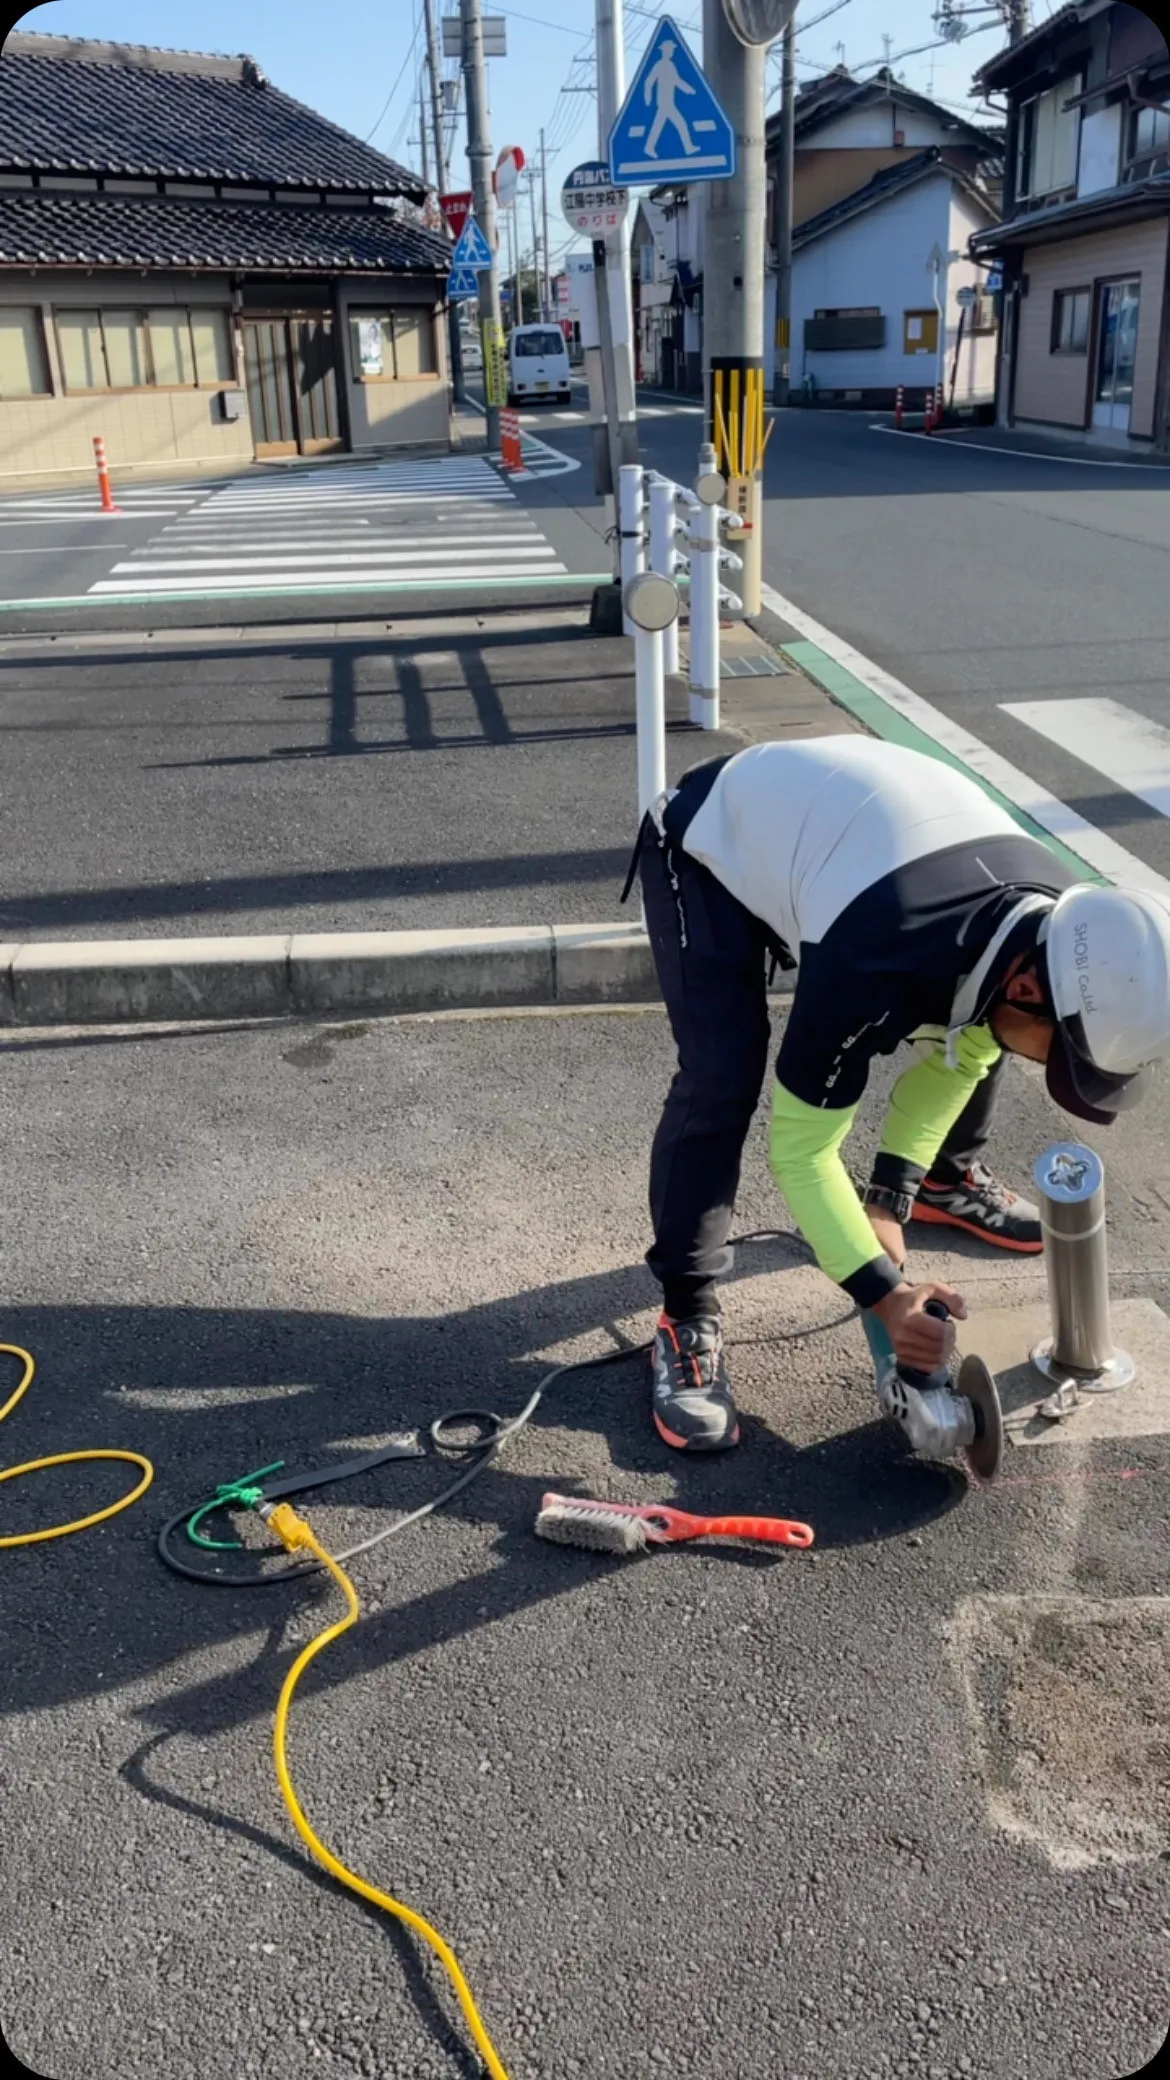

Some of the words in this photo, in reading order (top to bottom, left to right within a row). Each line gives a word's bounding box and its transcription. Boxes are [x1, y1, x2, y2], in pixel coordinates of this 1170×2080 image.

[578, 213, 617, 228] のりば
[1074, 922, 1089, 971] SHOBI
